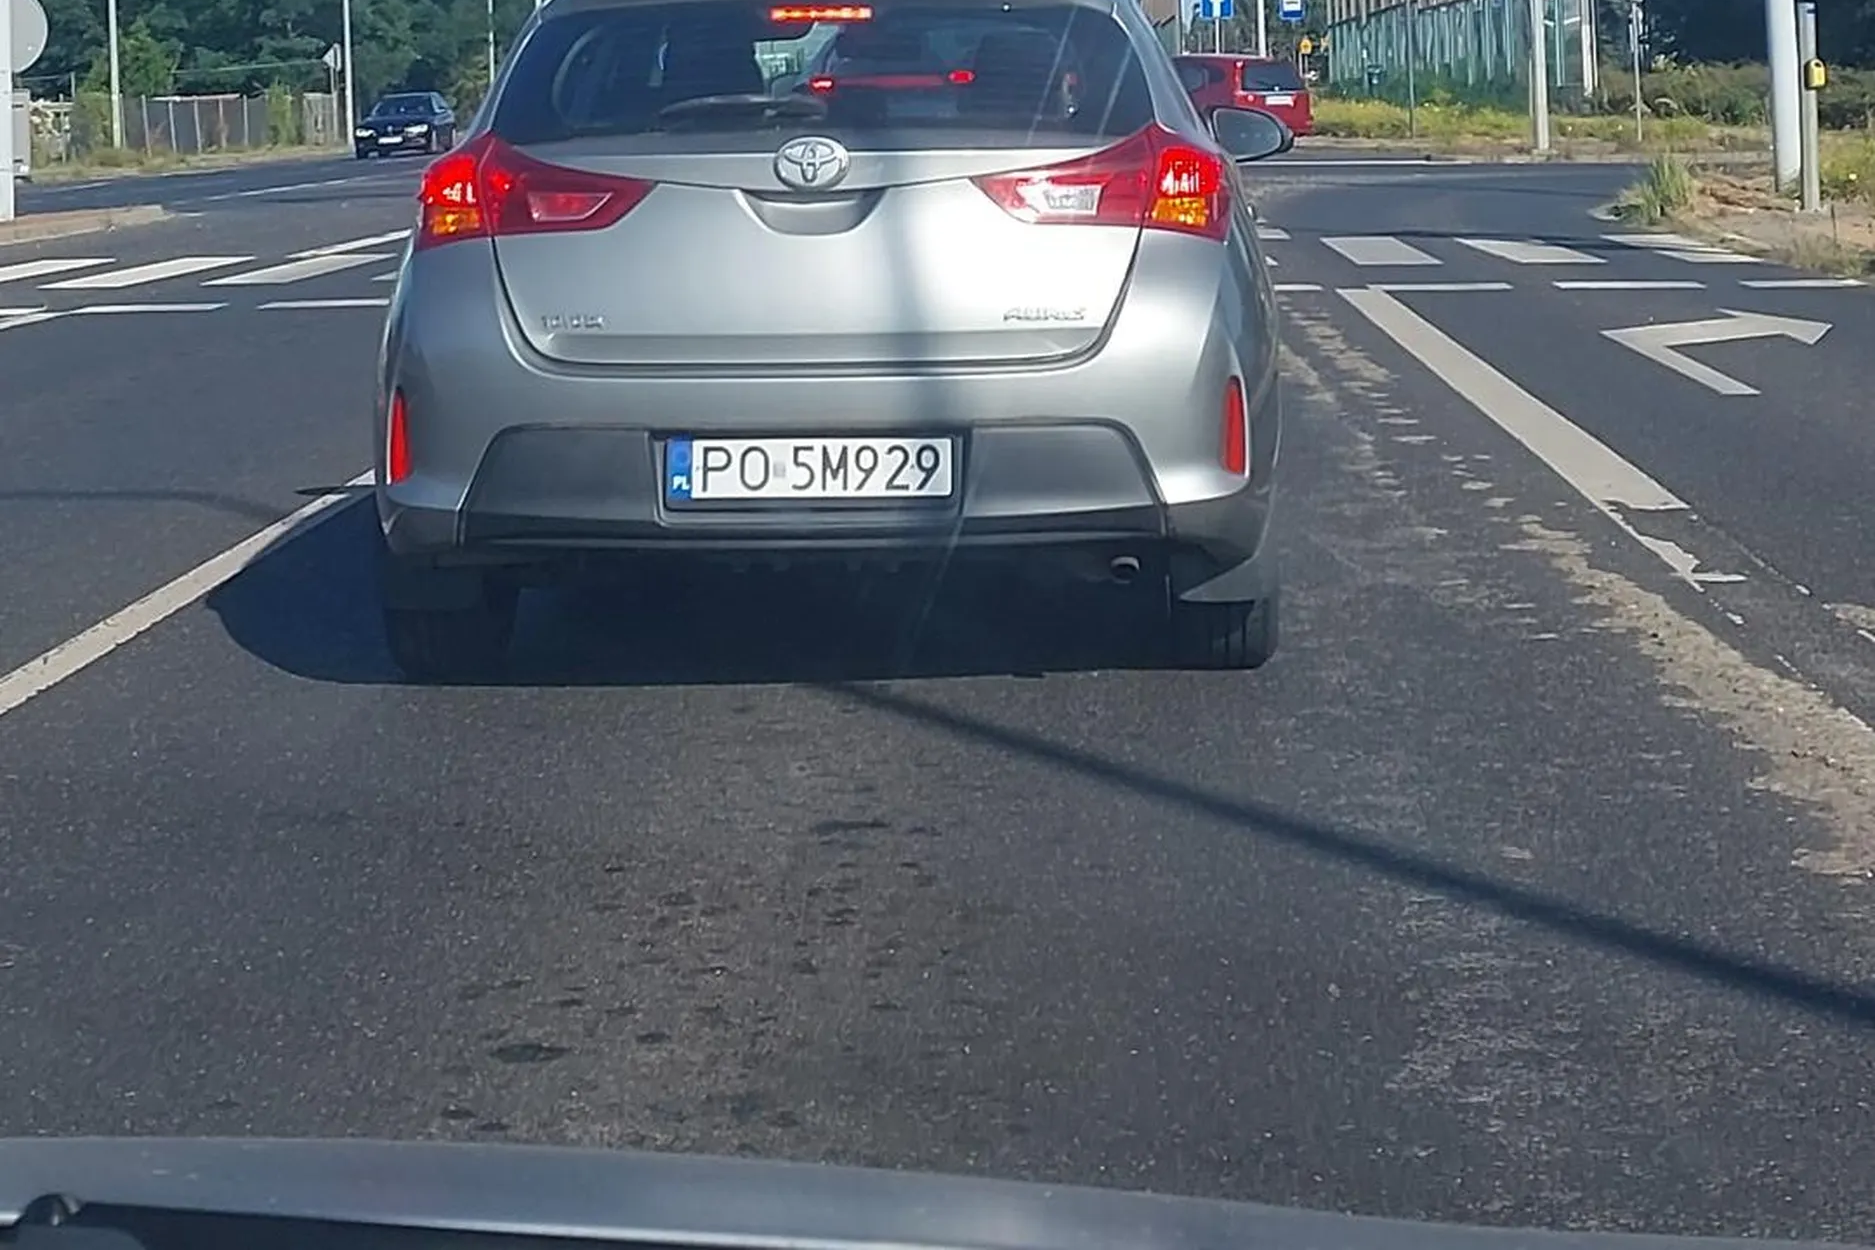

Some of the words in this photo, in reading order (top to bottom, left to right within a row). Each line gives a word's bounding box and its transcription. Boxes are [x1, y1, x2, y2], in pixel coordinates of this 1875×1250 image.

[673, 475, 690, 490] PL
[702, 445, 770, 493] PO
[792, 444, 941, 492] 5M929
